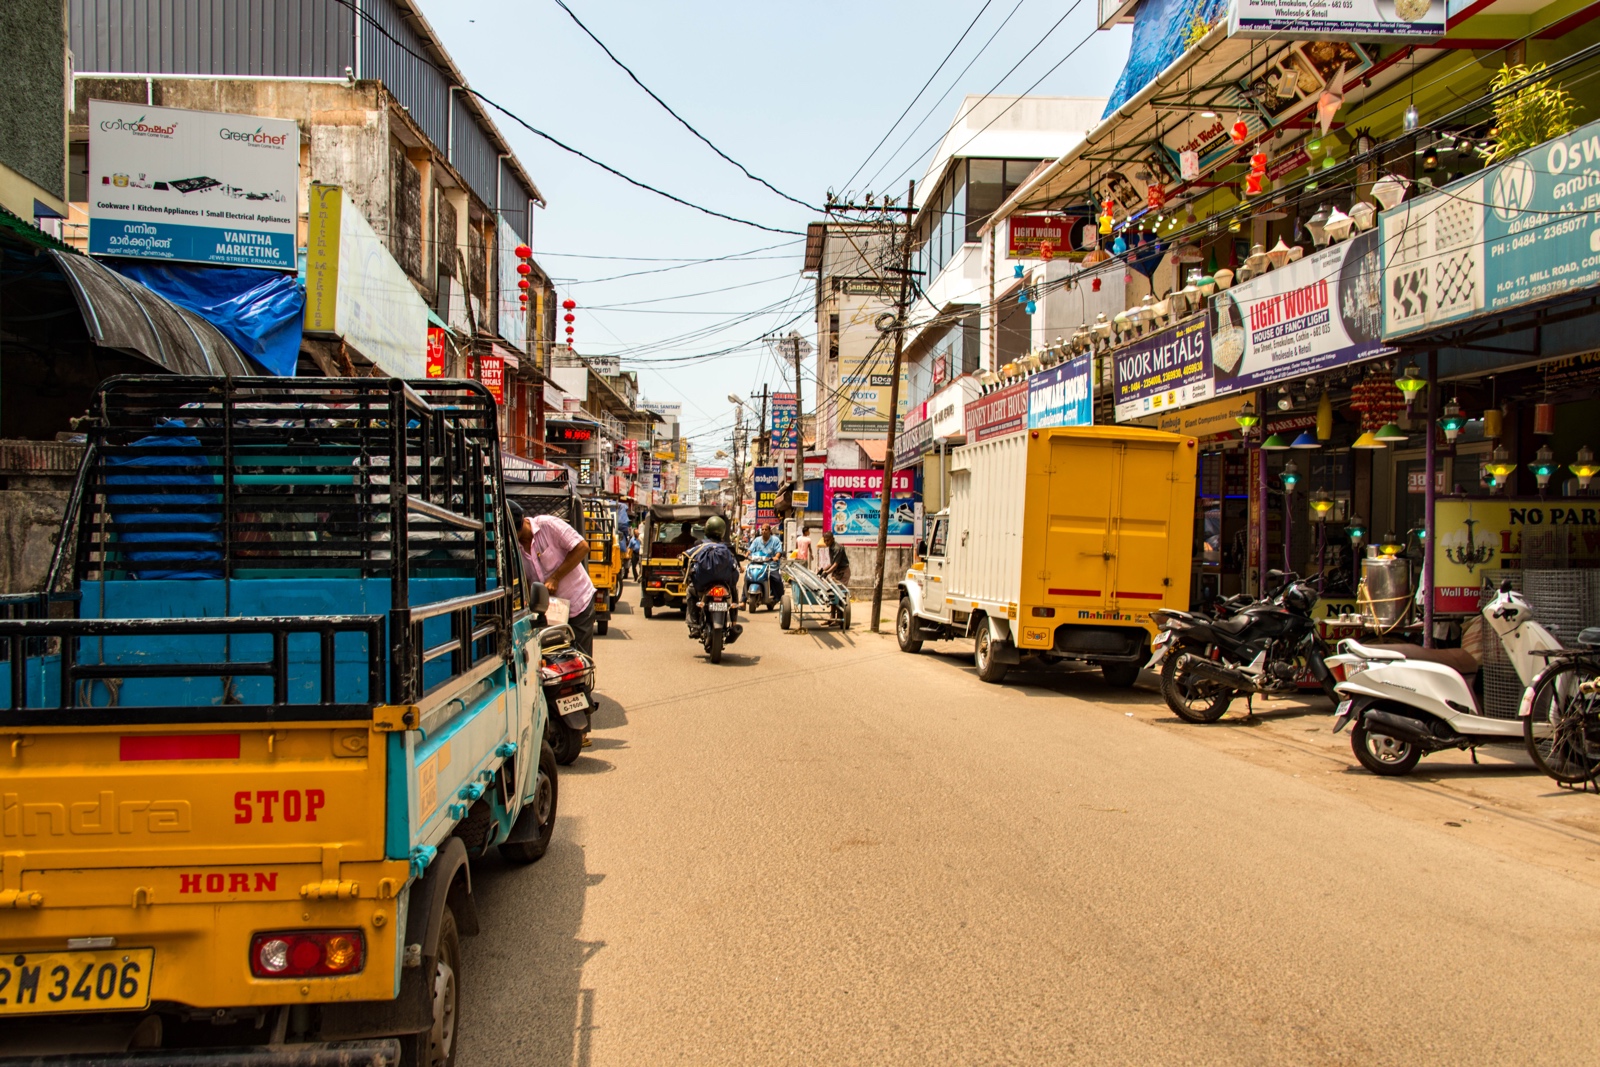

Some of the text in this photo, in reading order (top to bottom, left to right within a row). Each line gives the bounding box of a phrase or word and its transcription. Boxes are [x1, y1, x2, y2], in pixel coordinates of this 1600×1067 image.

[1275, 8, 1305, 16] Wholesale
[1311, 9, 1328, 17] Retail
[219, 127, 286, 146] Greenchef
[1197, 121, 1225, 143] World
[97, 201, 291, 224] Cookware Kitchen Appliances Small Electrical Appliances
[1507, 210, 1549, 235] 40/4944
[1558, 201, 1577, 218] A3,
[124, 223, 157, 235] വനിത
[1014, 226, 1061, 238] LIGHT WORLD
[1491, 215, 1588, 258] PH 0484 2365077
[224, 231, 272, 246] VANITHA
[216, 243, 280, 259] MARKETING
[250, 258, 288, 266] ERNAKULAM
[1529, 269, 1551, 283] MILL
[1551, 261, 1580, 277] ROAD,
[1250, 295, 1282, 332] LIGHT
[1283, 278, 1329, 321] WORLD
[1492, 298, 1509, 308] Fax:
[1253, 311, 1328, 344] HOUSE OF FANCY LIGHT
[1119, 331, 1205, 383] NOOR METALS
[1271, 347, 1294, 362] Wholesale
[966, 405, 987, 430] HONEY
[987, 397, 1007, 424] LIGHT
[1007, 390, 1028, 418] HOUS
[1161, 416, 1181, 429] Ambuja
[829, 475, 867, 489] HOUSE
[868, 476, 882, 489] OF
[757, 500, 776, 509] SAL
[760, 492, 778, 501] BIG
[1509, 508, 1600, 525] NO PAR
[1440, 587, 1461, 597] Wall
[1077, 609, 1132, 622] mahindra
[234, 789, 326, 825] STOP
[179, 872, 279, 894] HORN
[48, 961, 141, 1003] 3406
